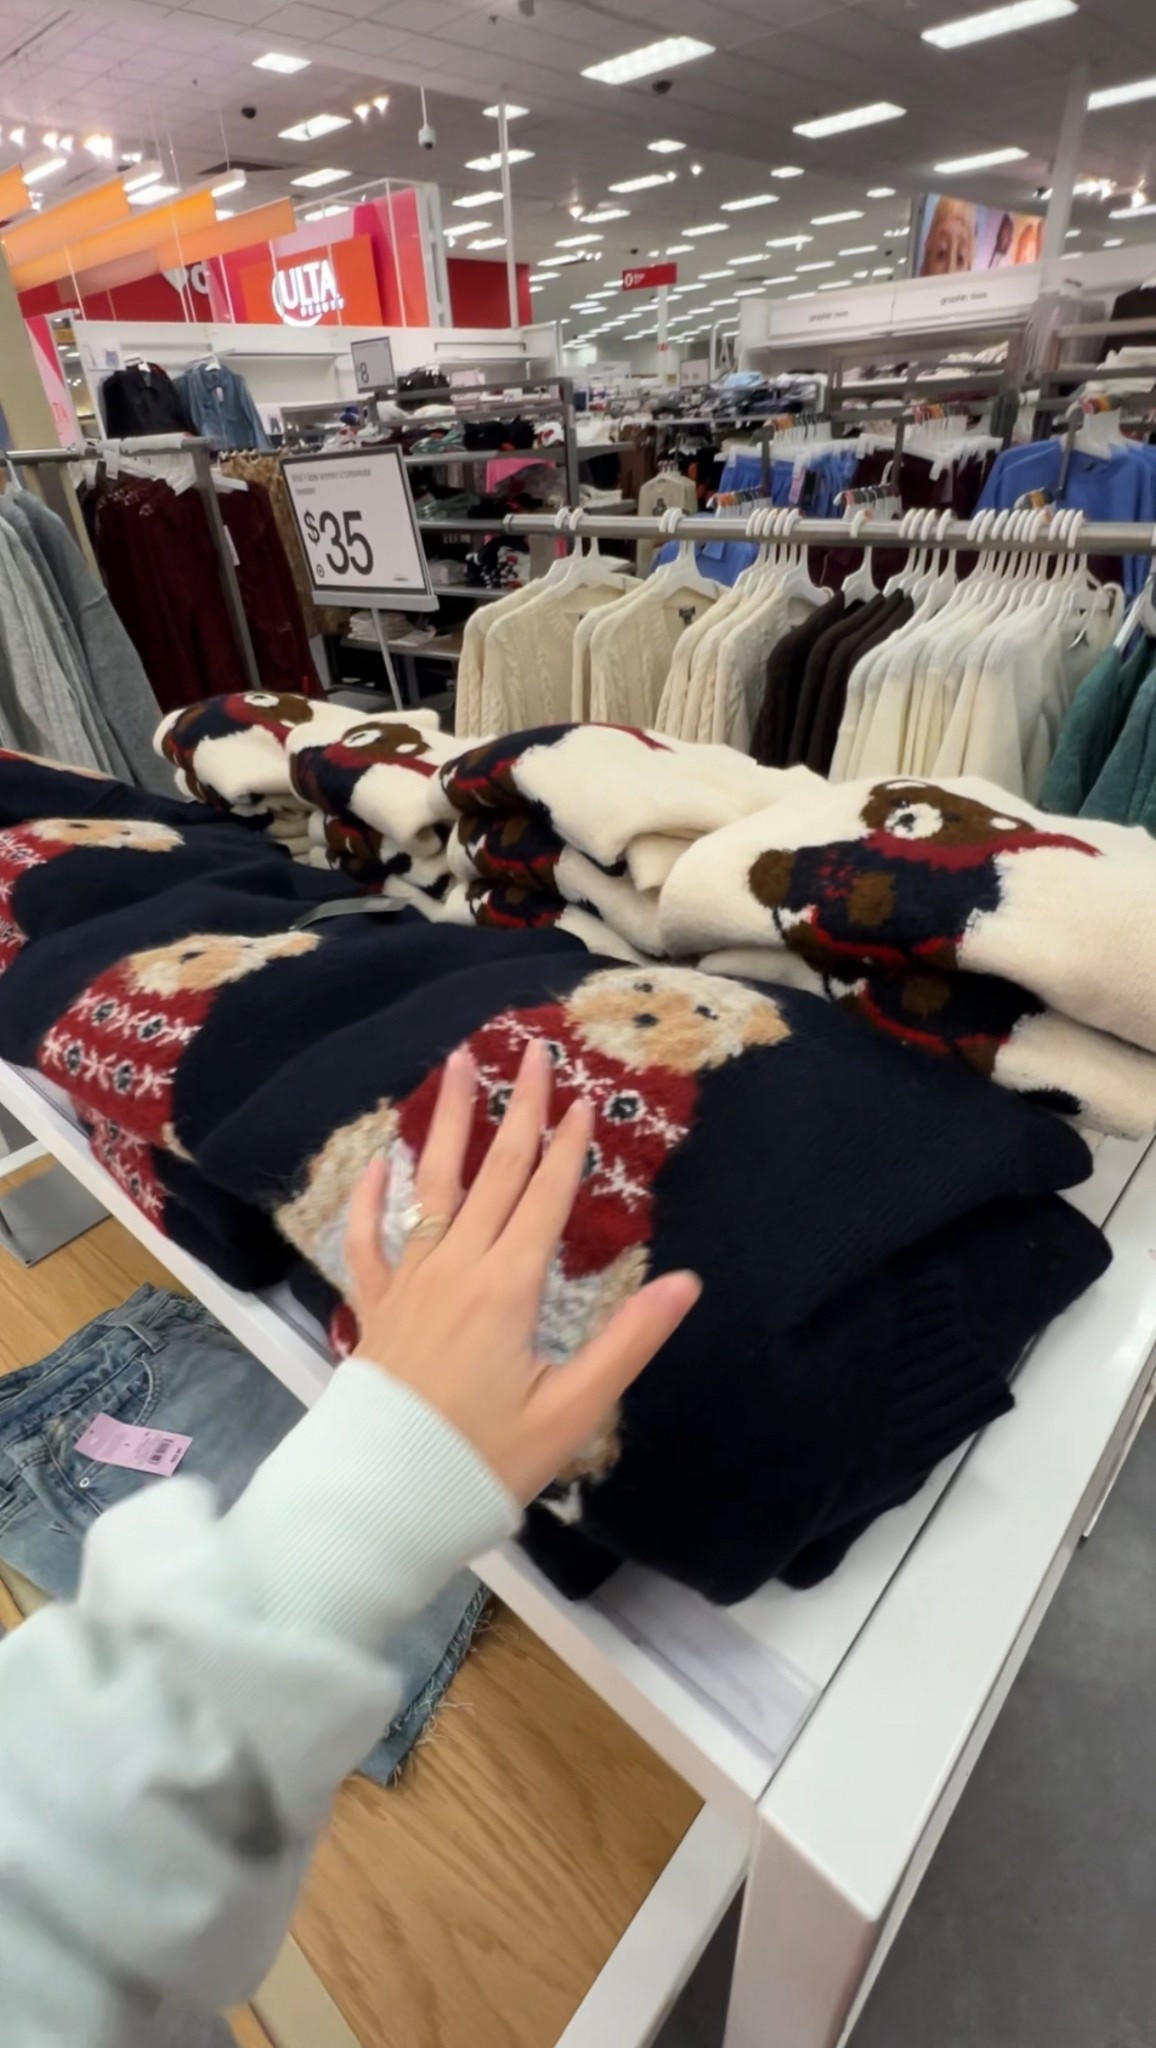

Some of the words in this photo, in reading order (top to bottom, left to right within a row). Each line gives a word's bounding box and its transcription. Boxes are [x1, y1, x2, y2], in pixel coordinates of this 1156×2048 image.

[277, 259, 337, 310] ULTA
[300, 297, 344, 318] BEAUTY
[303, 509, 374, 576] $35
